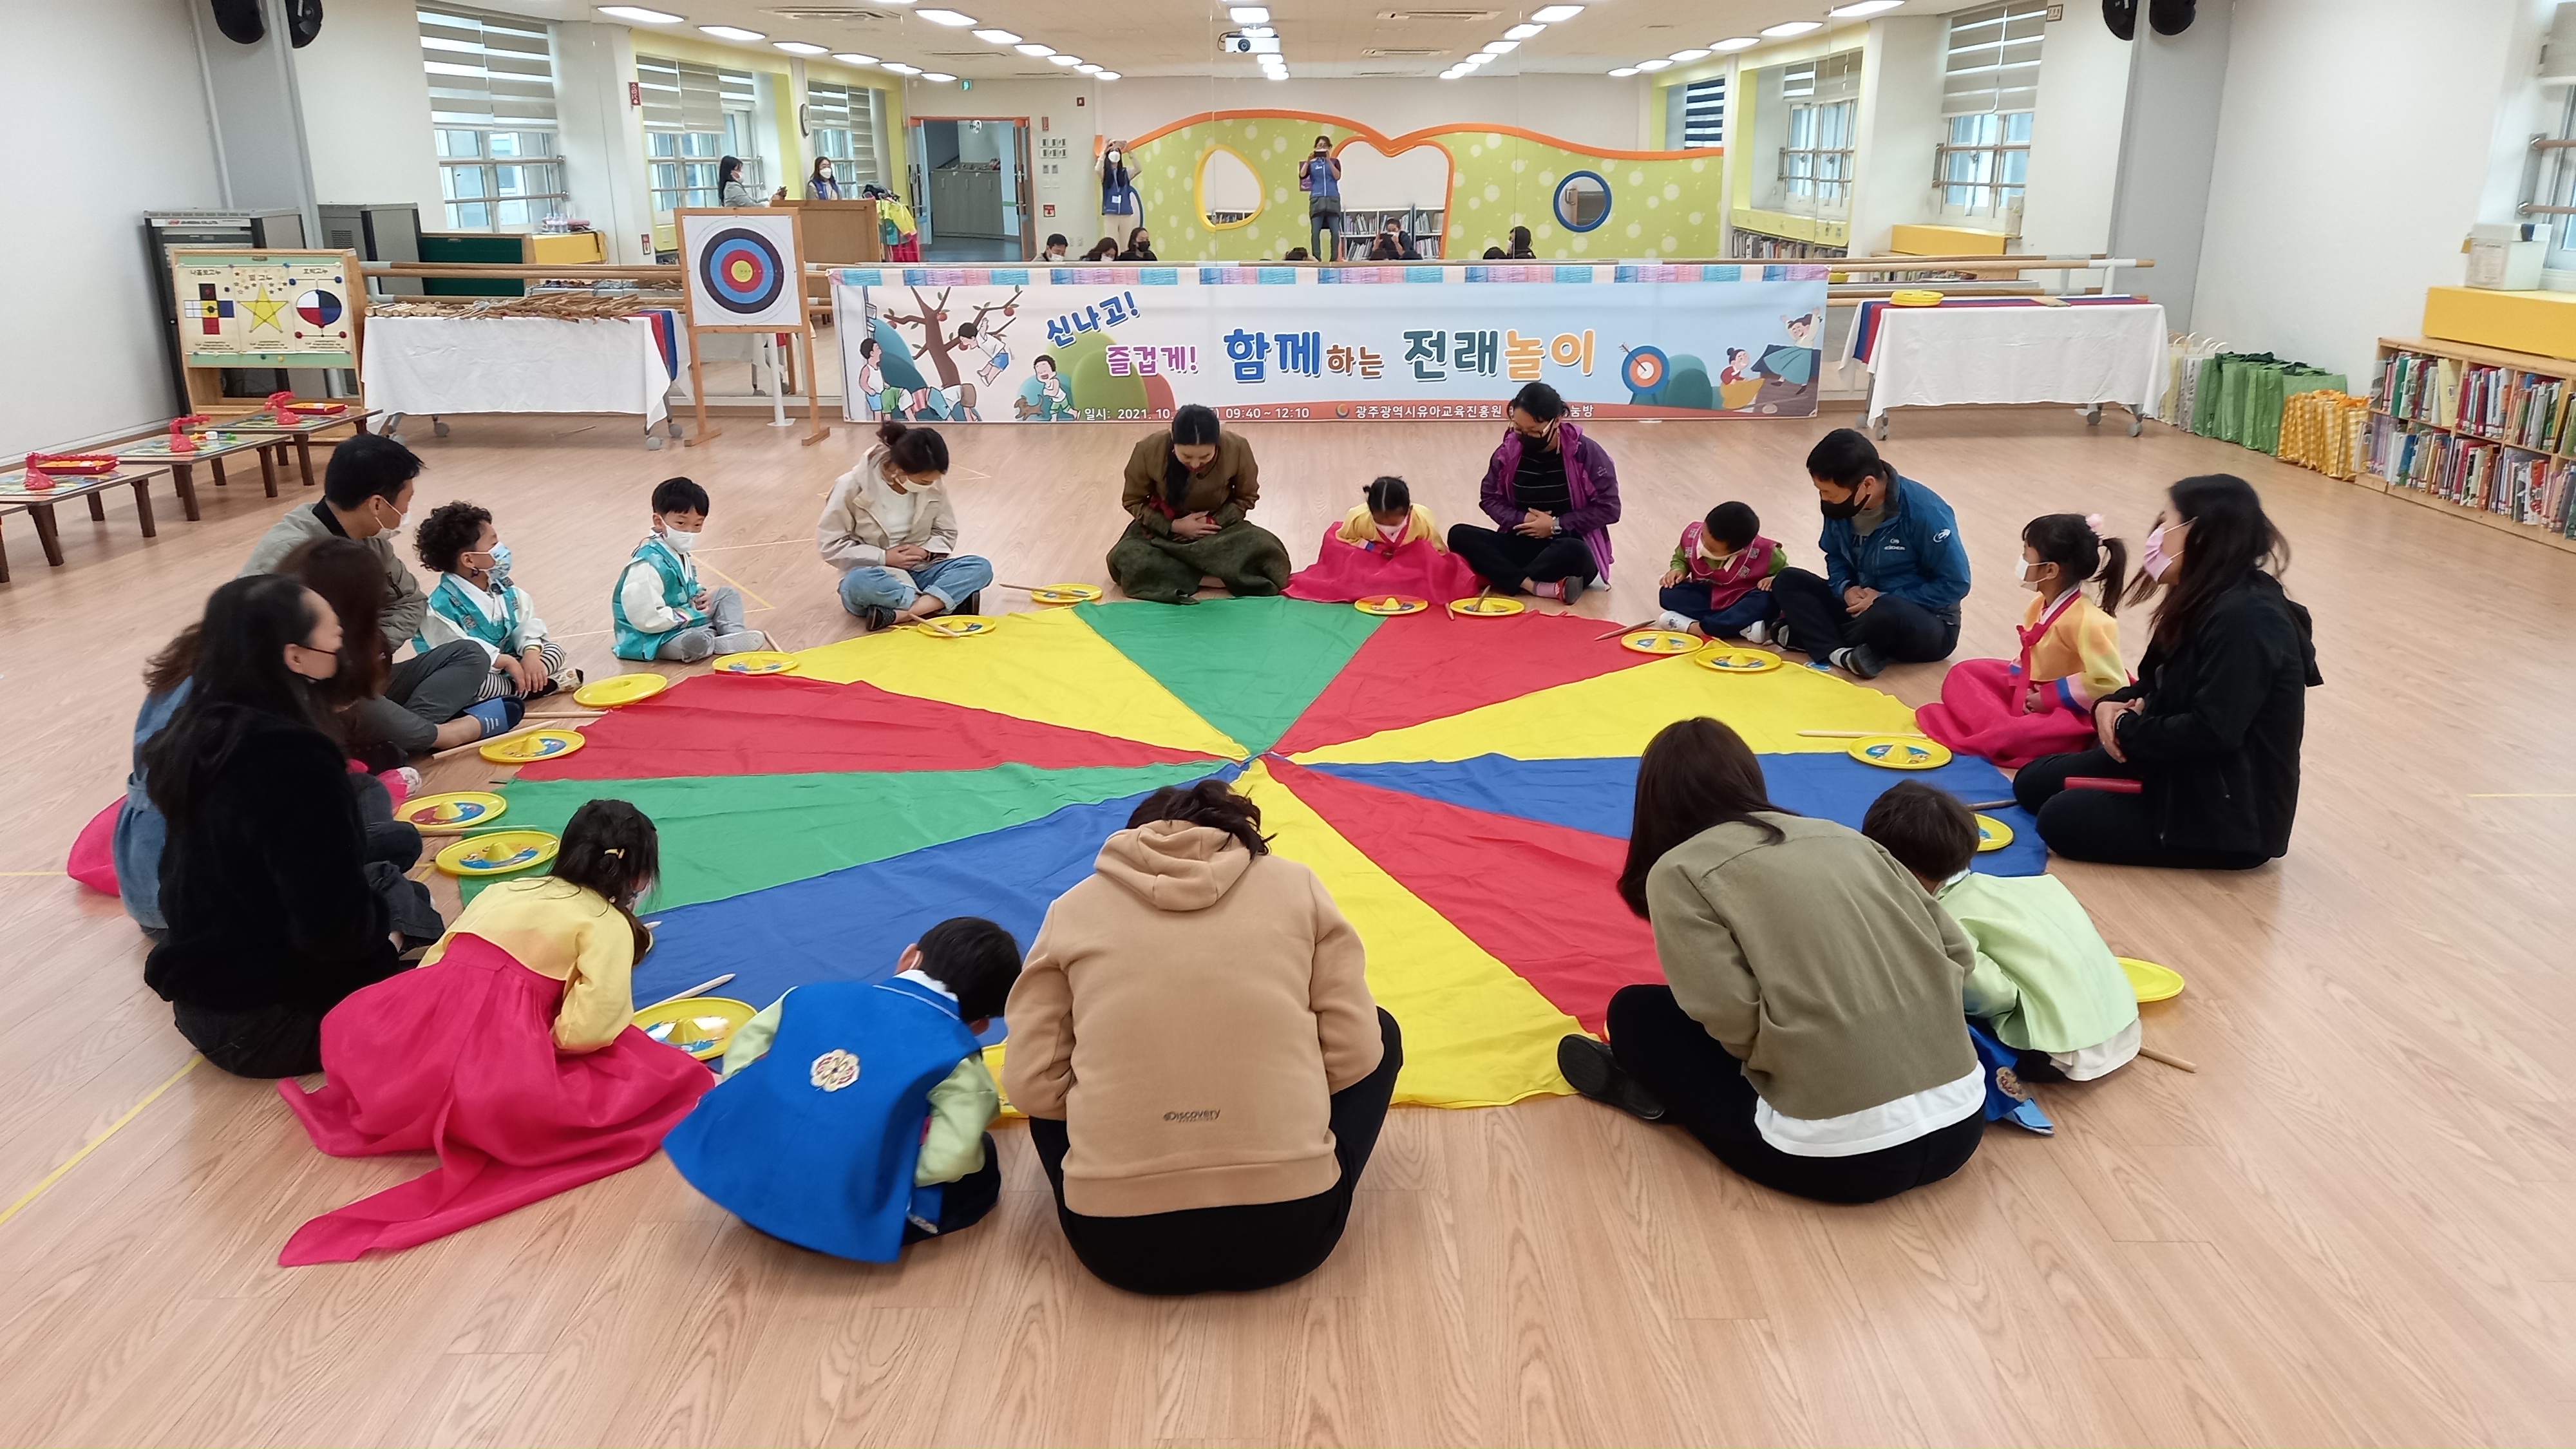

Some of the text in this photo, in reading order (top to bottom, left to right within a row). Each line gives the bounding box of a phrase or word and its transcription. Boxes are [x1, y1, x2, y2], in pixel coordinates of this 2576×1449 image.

[1046, 290, 1140, 348] 신나고!
[1107, 345, 1198, 375] 즐겁게!
[1222, 327, 1595, 383] 함께하는 전래놀이
[1084, 407, 1112, 421] 일시:
[1117, 408, 1152, 420] 2021.
[1155, 408, 1175, 420] 10.
[1355, 404, 1502, 419] 광주광역시유아교육진흥원
[1564, 404, 1595, 418] 눔방
